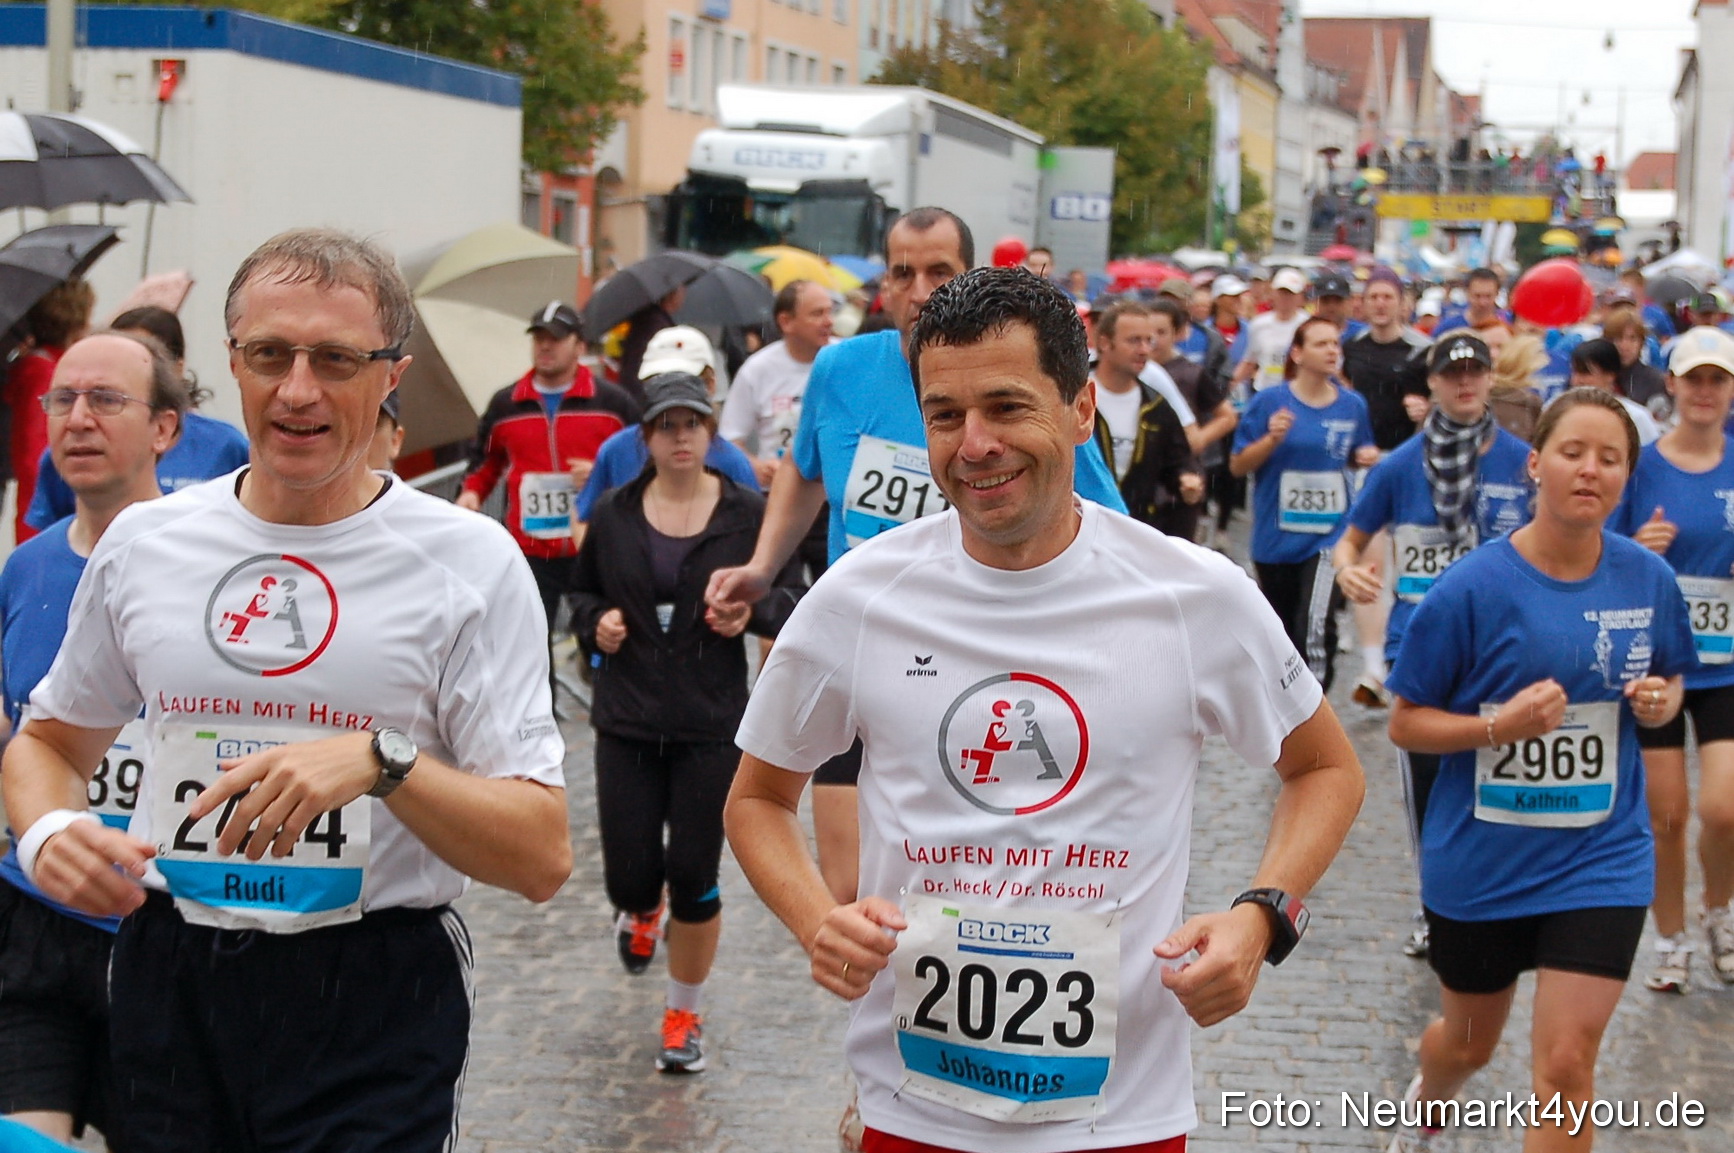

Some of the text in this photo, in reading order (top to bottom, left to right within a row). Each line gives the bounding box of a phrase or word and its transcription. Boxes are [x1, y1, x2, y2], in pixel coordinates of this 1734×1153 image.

[527, 490, 578, 514] 313
[1287, 489, 1337, 512] 2831
[906, 667, 938, 677] erima
[159, 690, 374, 731] LAUFEN MIT HERZ
[1492, 734, 1604, 783] 2969
[1514, 793, 1579, 809] Kathrin
[904, 838, 1130, 869] LAUFEN MIT HERZ
[223, 873, 285, 904] Rudi
[923, 878, 949, 894] Dr.
[953, 878, 992, 896] Heck
[1010, 881, 1036, 898] Dr.
[1041, 881, 1105, 899] Röschl
[957, 918, 1051, 945] BOCK
[913, 954, 1096, 1049] 2023
[937, 1050, 1065, 1096] Johannes
